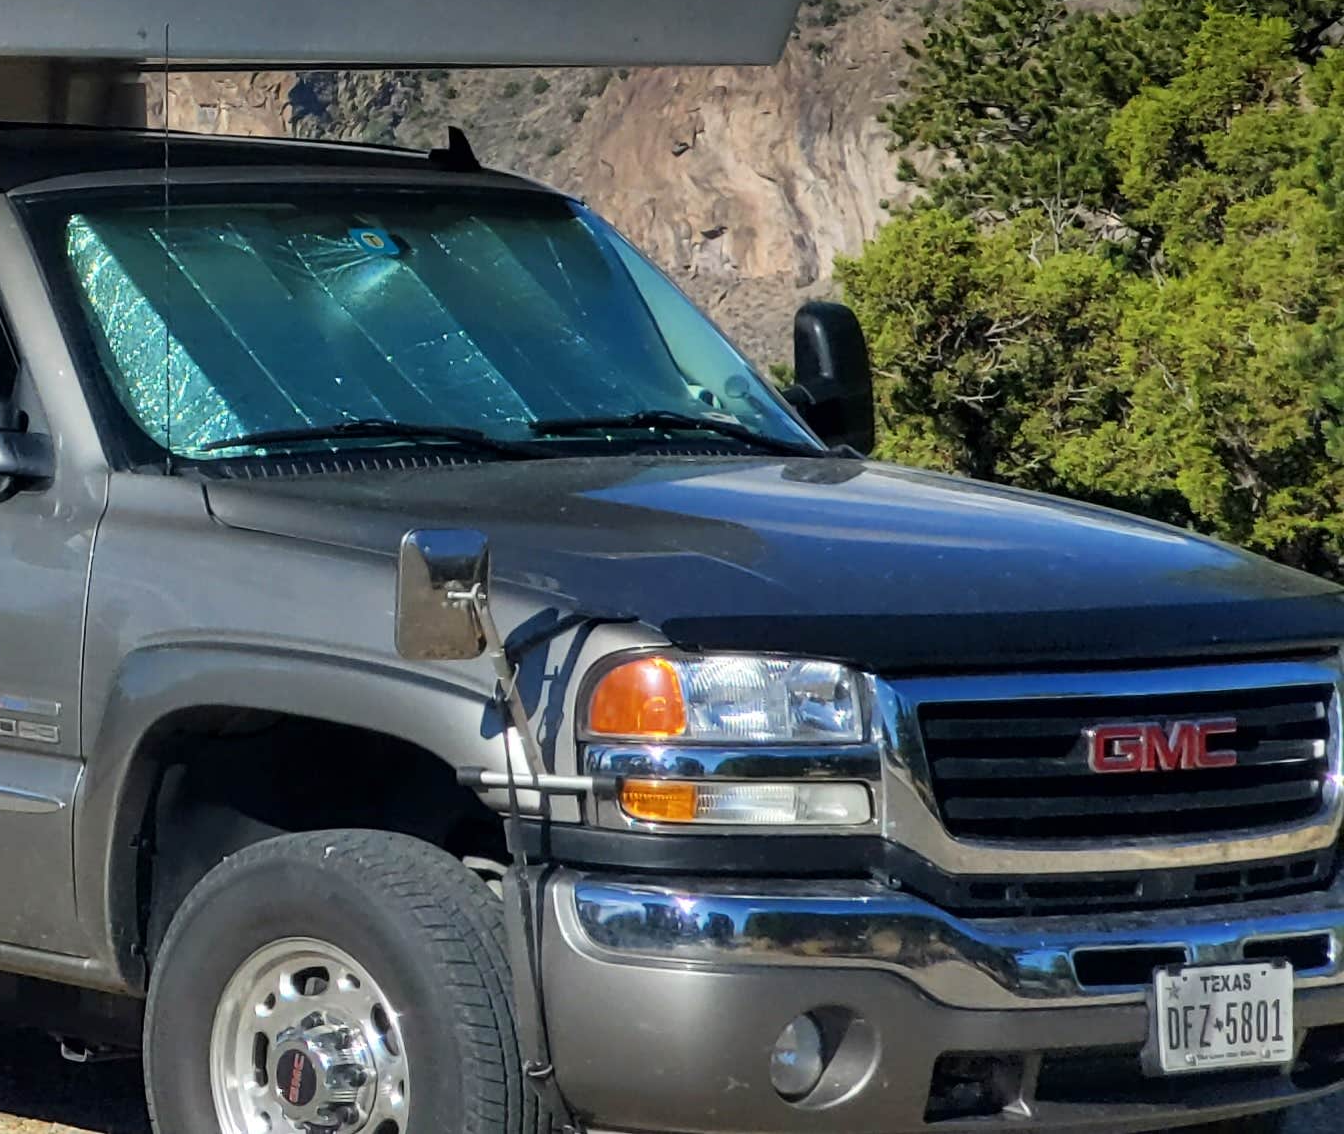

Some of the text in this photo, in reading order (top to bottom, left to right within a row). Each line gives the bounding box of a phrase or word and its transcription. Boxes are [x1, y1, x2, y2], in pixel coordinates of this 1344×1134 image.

[1087, 717, 1237, 773] GMC
[1200, 972, 1252, 994] TEXAS
[1225, 999, 1284, 1045] 5801
